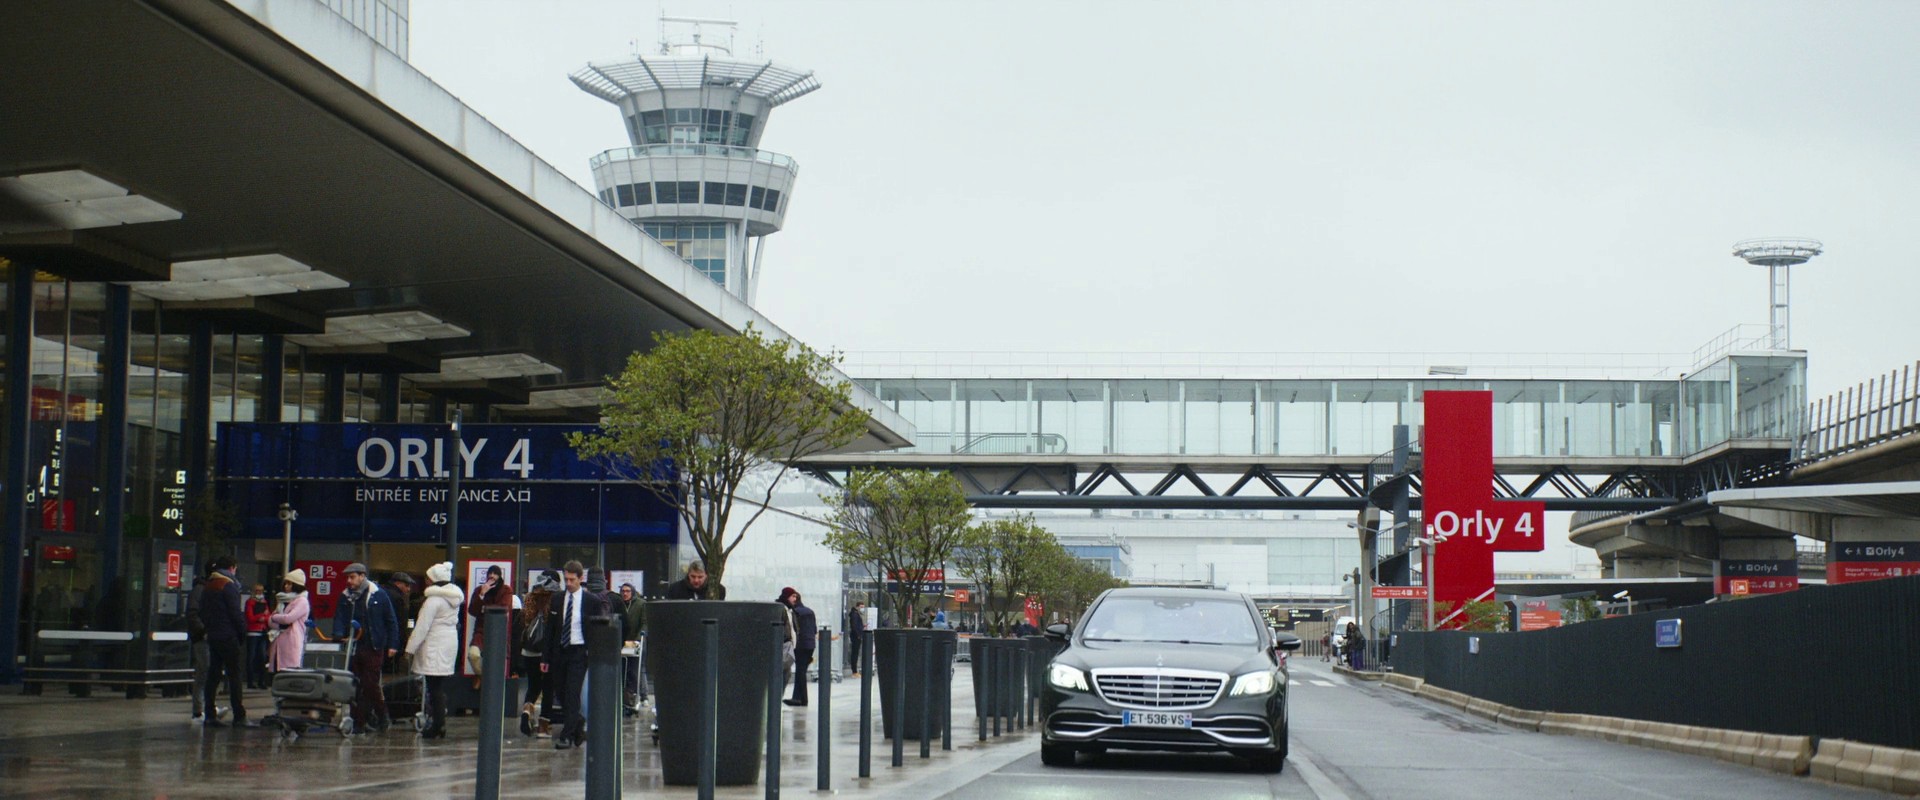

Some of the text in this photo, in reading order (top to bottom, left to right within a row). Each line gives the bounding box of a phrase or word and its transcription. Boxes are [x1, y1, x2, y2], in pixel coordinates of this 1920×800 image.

[356, 437, 534, 479] ORLY 4
[356, 486, 531, 503] ENTRÉE ENTANCE 入口
[430, 512, 448, 525] 45
[1434, 509, 1535, 544] Orly 4
[1875, 546, 1905, 558] Orly 4
[1753, 564, 1778, 573] Orly 4
